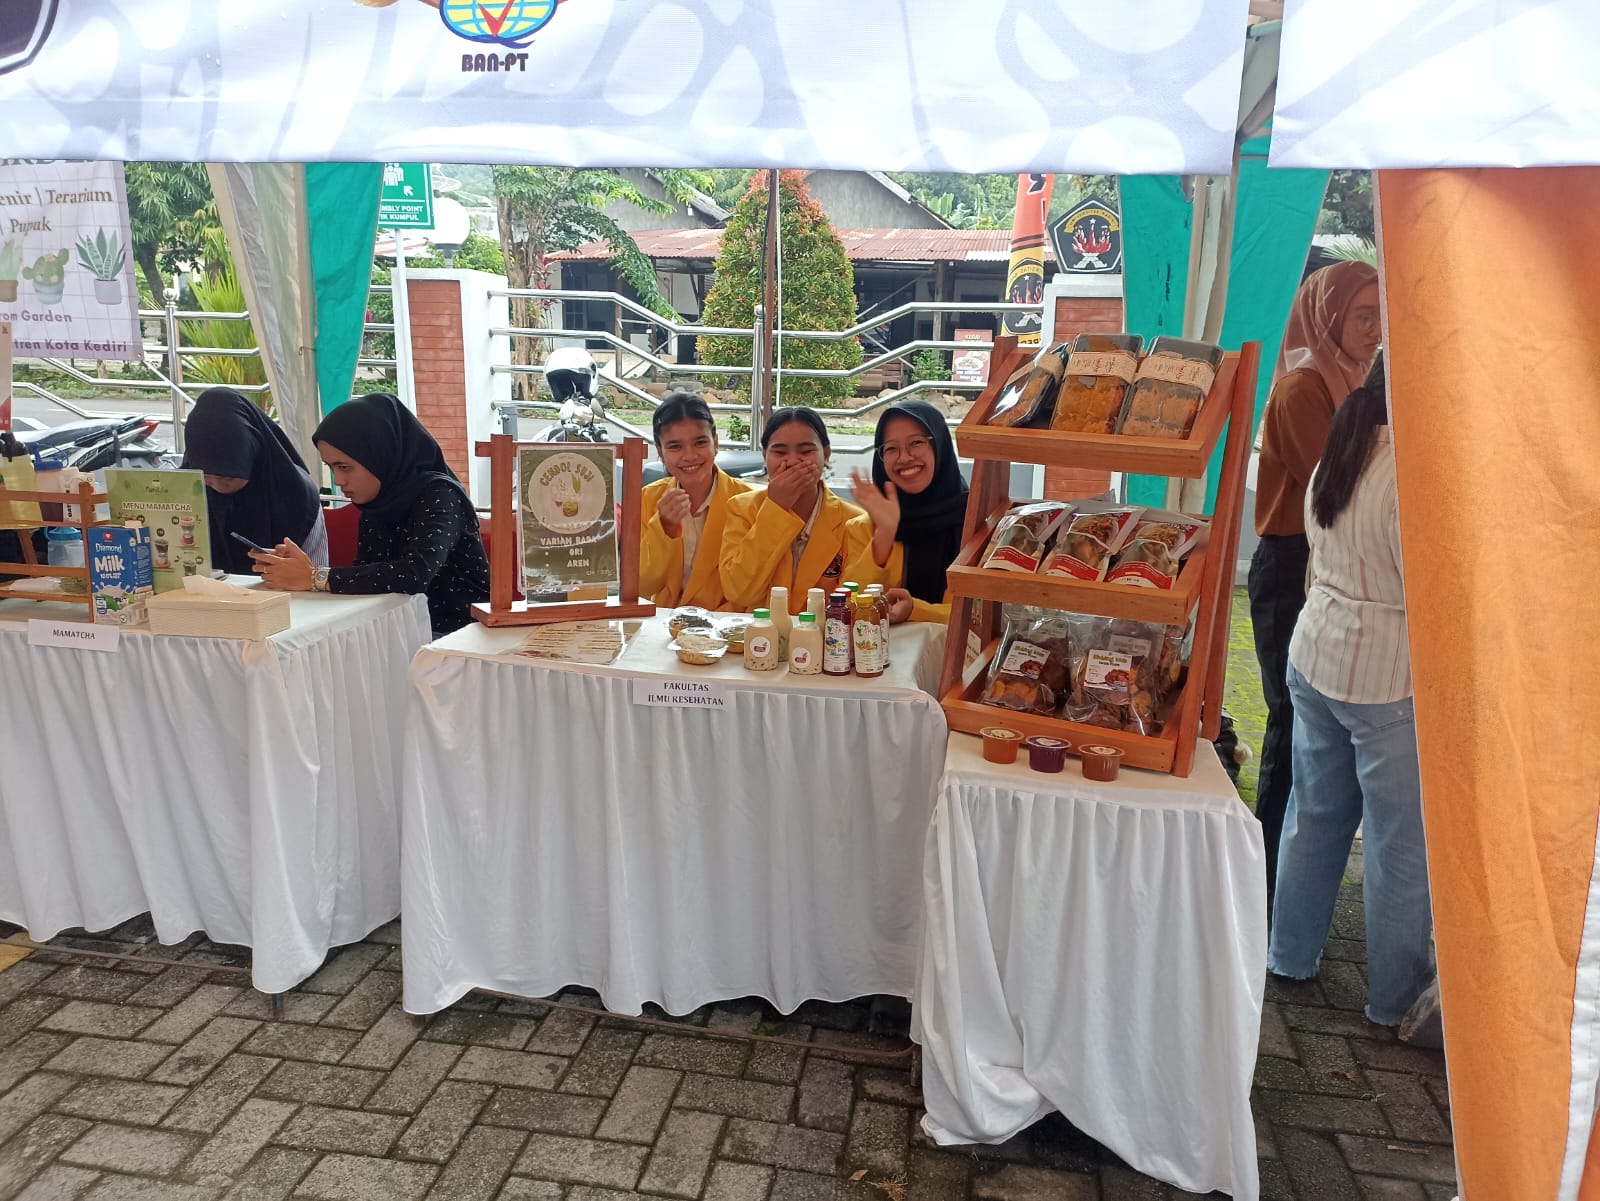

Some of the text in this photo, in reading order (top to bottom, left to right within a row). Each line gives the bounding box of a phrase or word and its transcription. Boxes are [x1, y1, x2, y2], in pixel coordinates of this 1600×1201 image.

[462, 52, 528, 72] BAN-PT
[45, 188, 113, 205] Terarium
[21, 310, 72, 323] Garden
[14, 339, 127, 352] tren Kota Kediri
[96, 543, 122, 553] Diamond
[569, 548, 583, 556] ORI
[94, 555, 126, 573] Milk
[53, 629, 95, 639] MAMATCHA
[664, 682, 709, 691] FAKULTAS
[648, 694, 724, 705] ILMU KESEHATAN
